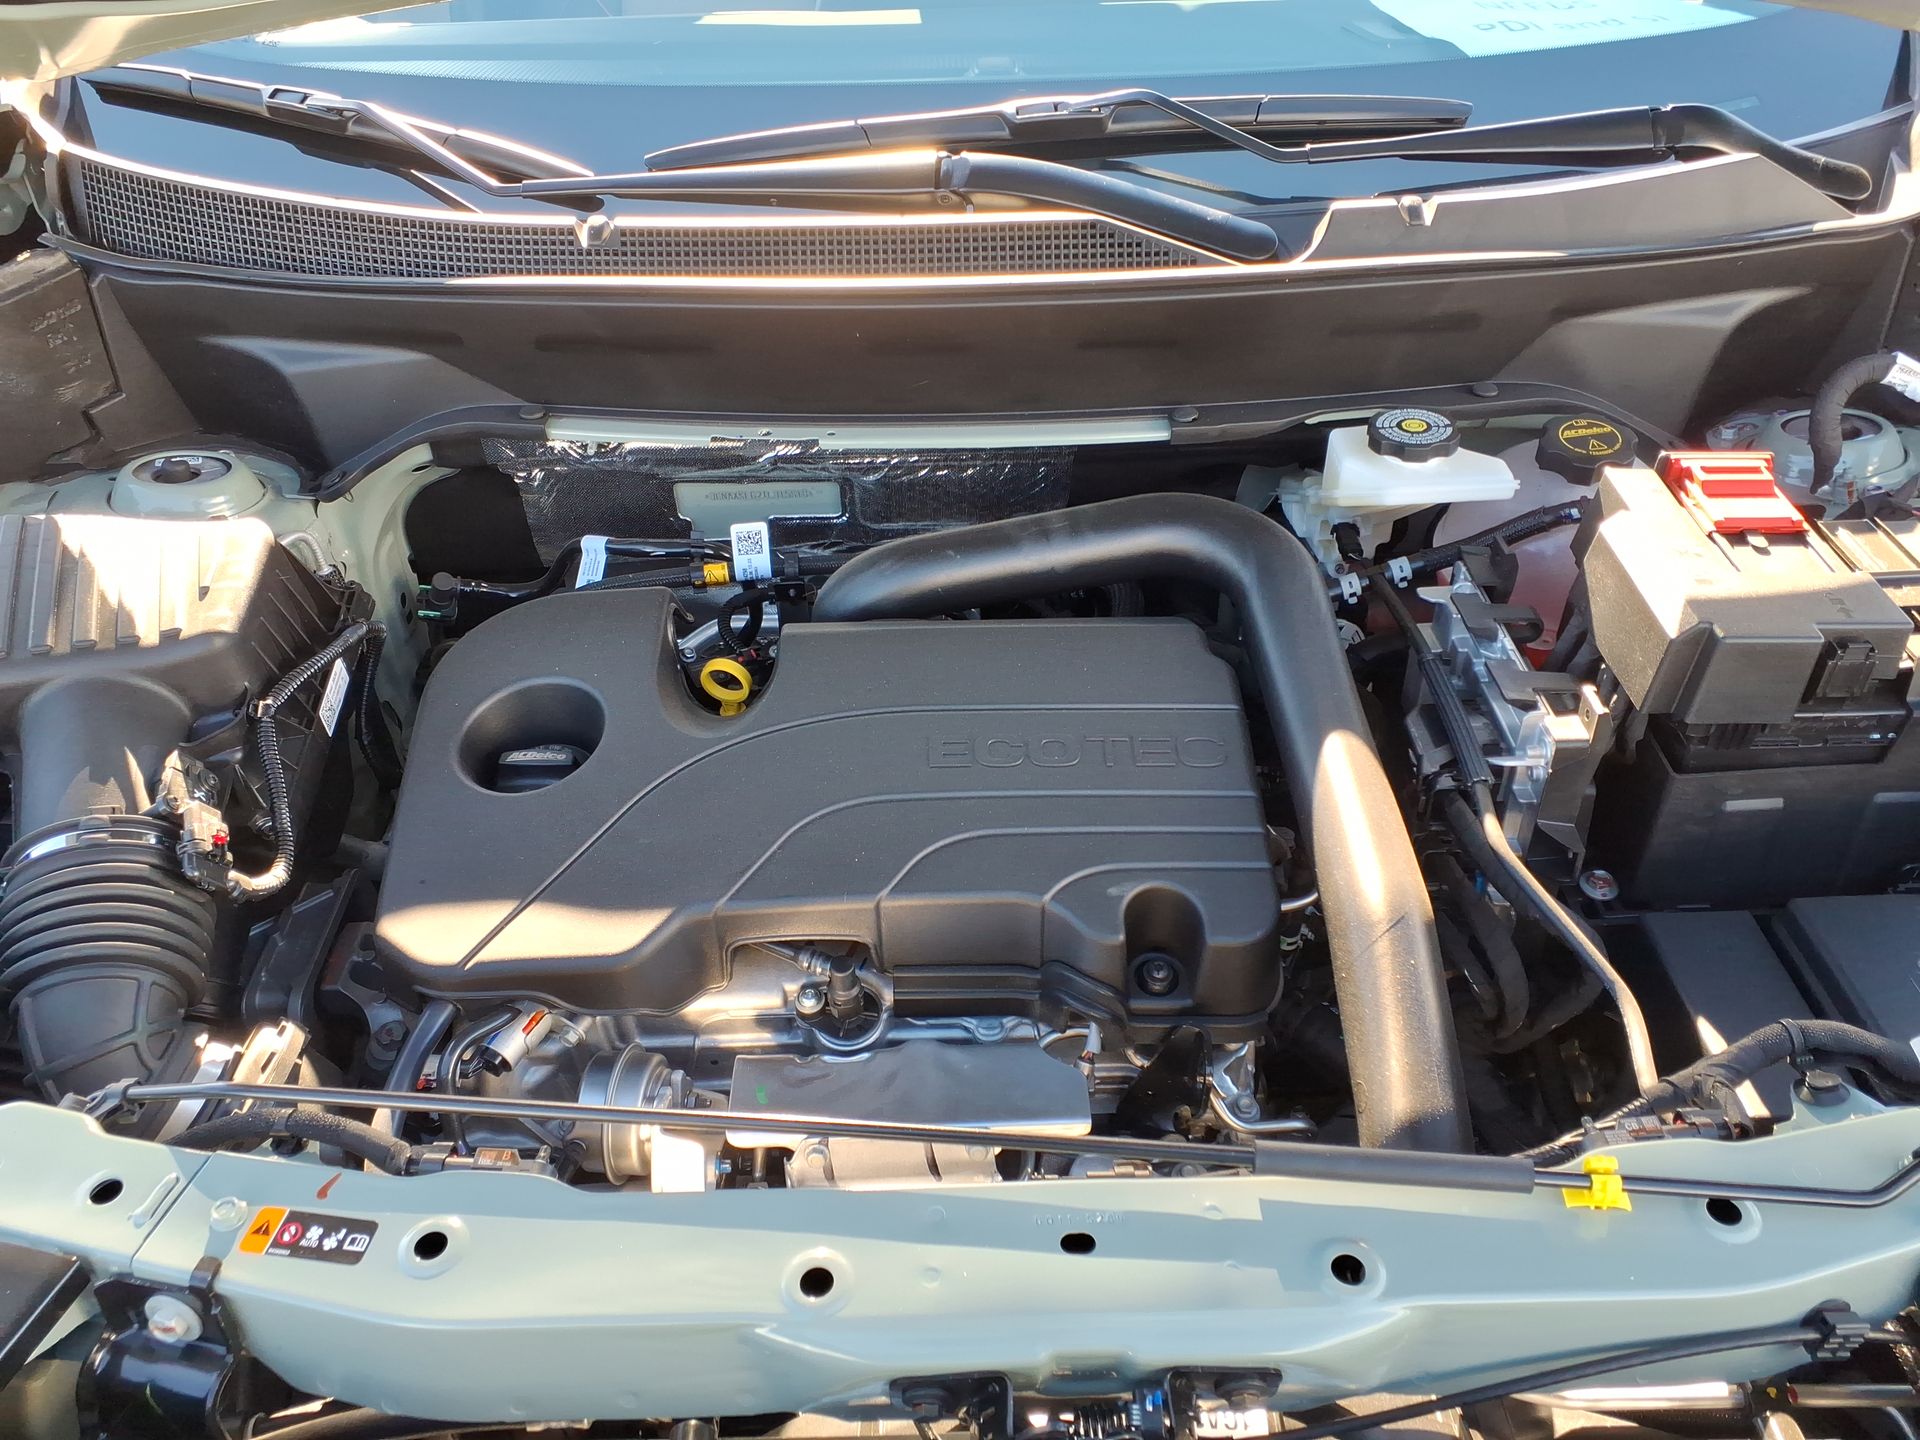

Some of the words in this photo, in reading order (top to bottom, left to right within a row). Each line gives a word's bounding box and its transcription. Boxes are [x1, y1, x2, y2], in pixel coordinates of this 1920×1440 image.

[1563, 427, 1611, 439] ACDelco
[506, 751, 566, 761] ACDelco
[927, 735, 1227, 768] ECOTEC
[299, 1239, 319, 1248] AUTO
